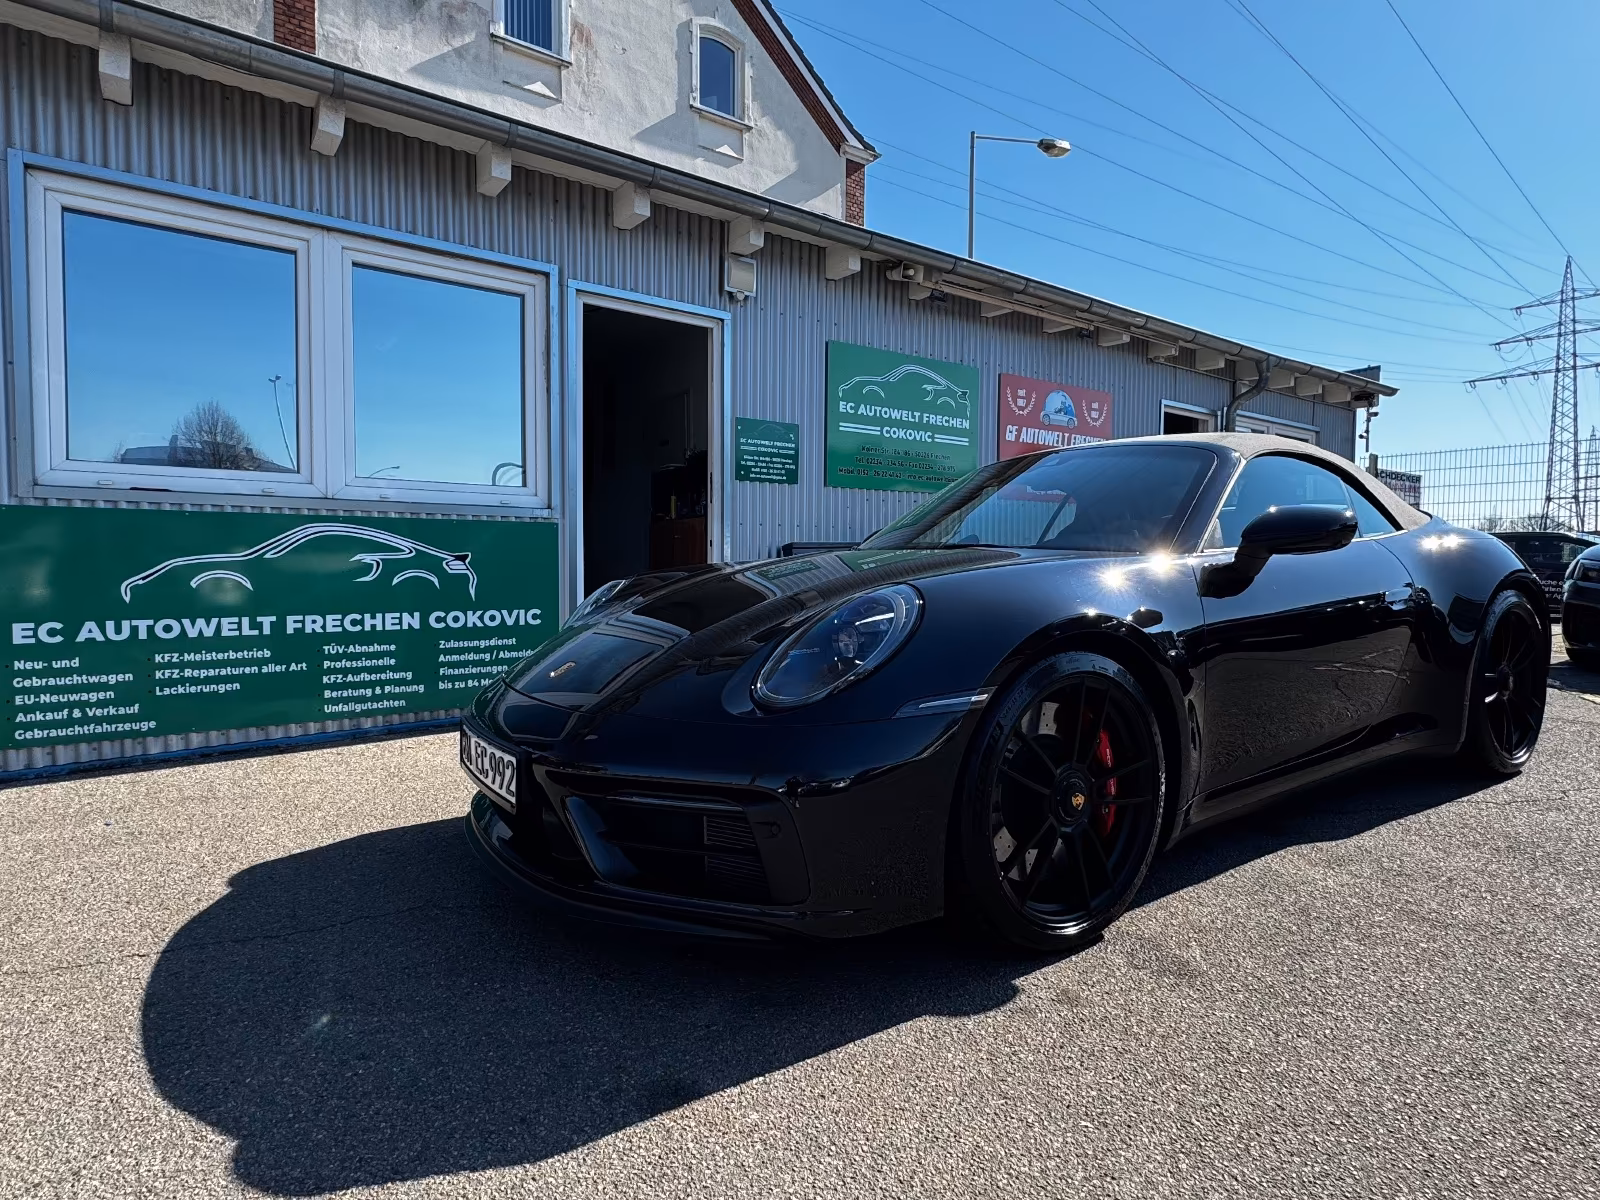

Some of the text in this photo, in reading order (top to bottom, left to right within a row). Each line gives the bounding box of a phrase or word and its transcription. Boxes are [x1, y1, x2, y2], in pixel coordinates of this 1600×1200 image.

[839, 401, 970, 430] EC AUTOWELT FRECHEN
[882, 426, 932, 442] COKOVIC
[1006, 424, 1018, 442] GF
[1020, 427, 1070, 448] AUTOWELT
[1377, 471, 1421, 483] CHDECKER
[12, 608, 542, 645] EC AUTOWELT FRECHEN COKOVIC
[323, 642, 396, 655] TÜV-Abnahme
[438, 637, 516, 648] Zulassungsdienst
[14, 657, 80, 671] Neu- und
[154, 648, 272, 664] KFZ-Meisterbetrieb
[323, 656, 396, 670] Professionelle
[438, 652, 490, 662] Anmeldung
[155, 662, 308, 680] KFZ-Reparaturen aller Art
[322, 670, 413, 685] KFZ-Aufbereitung
[440, 665, 508, 676] Finanzierungen
[13, 672, 134, 688] Gebrauchtwagen
[438, 680, 452, 690] bis
[467, 679, 479, 688] 84
[156, 681, 241, 696] Lackierungen
[324, 682, 425, 699] Beratung & Planung
[15, 690, 115, 706] EU-Neuwagen
[324, 698, 406, 714] Unfallgutachten
[15, 703, 140, 723] Ankauf & Verkauf
[14, 719, 157, 740] Gebrauchtfahrzeuge
[489, 752, 515, 797] 992
